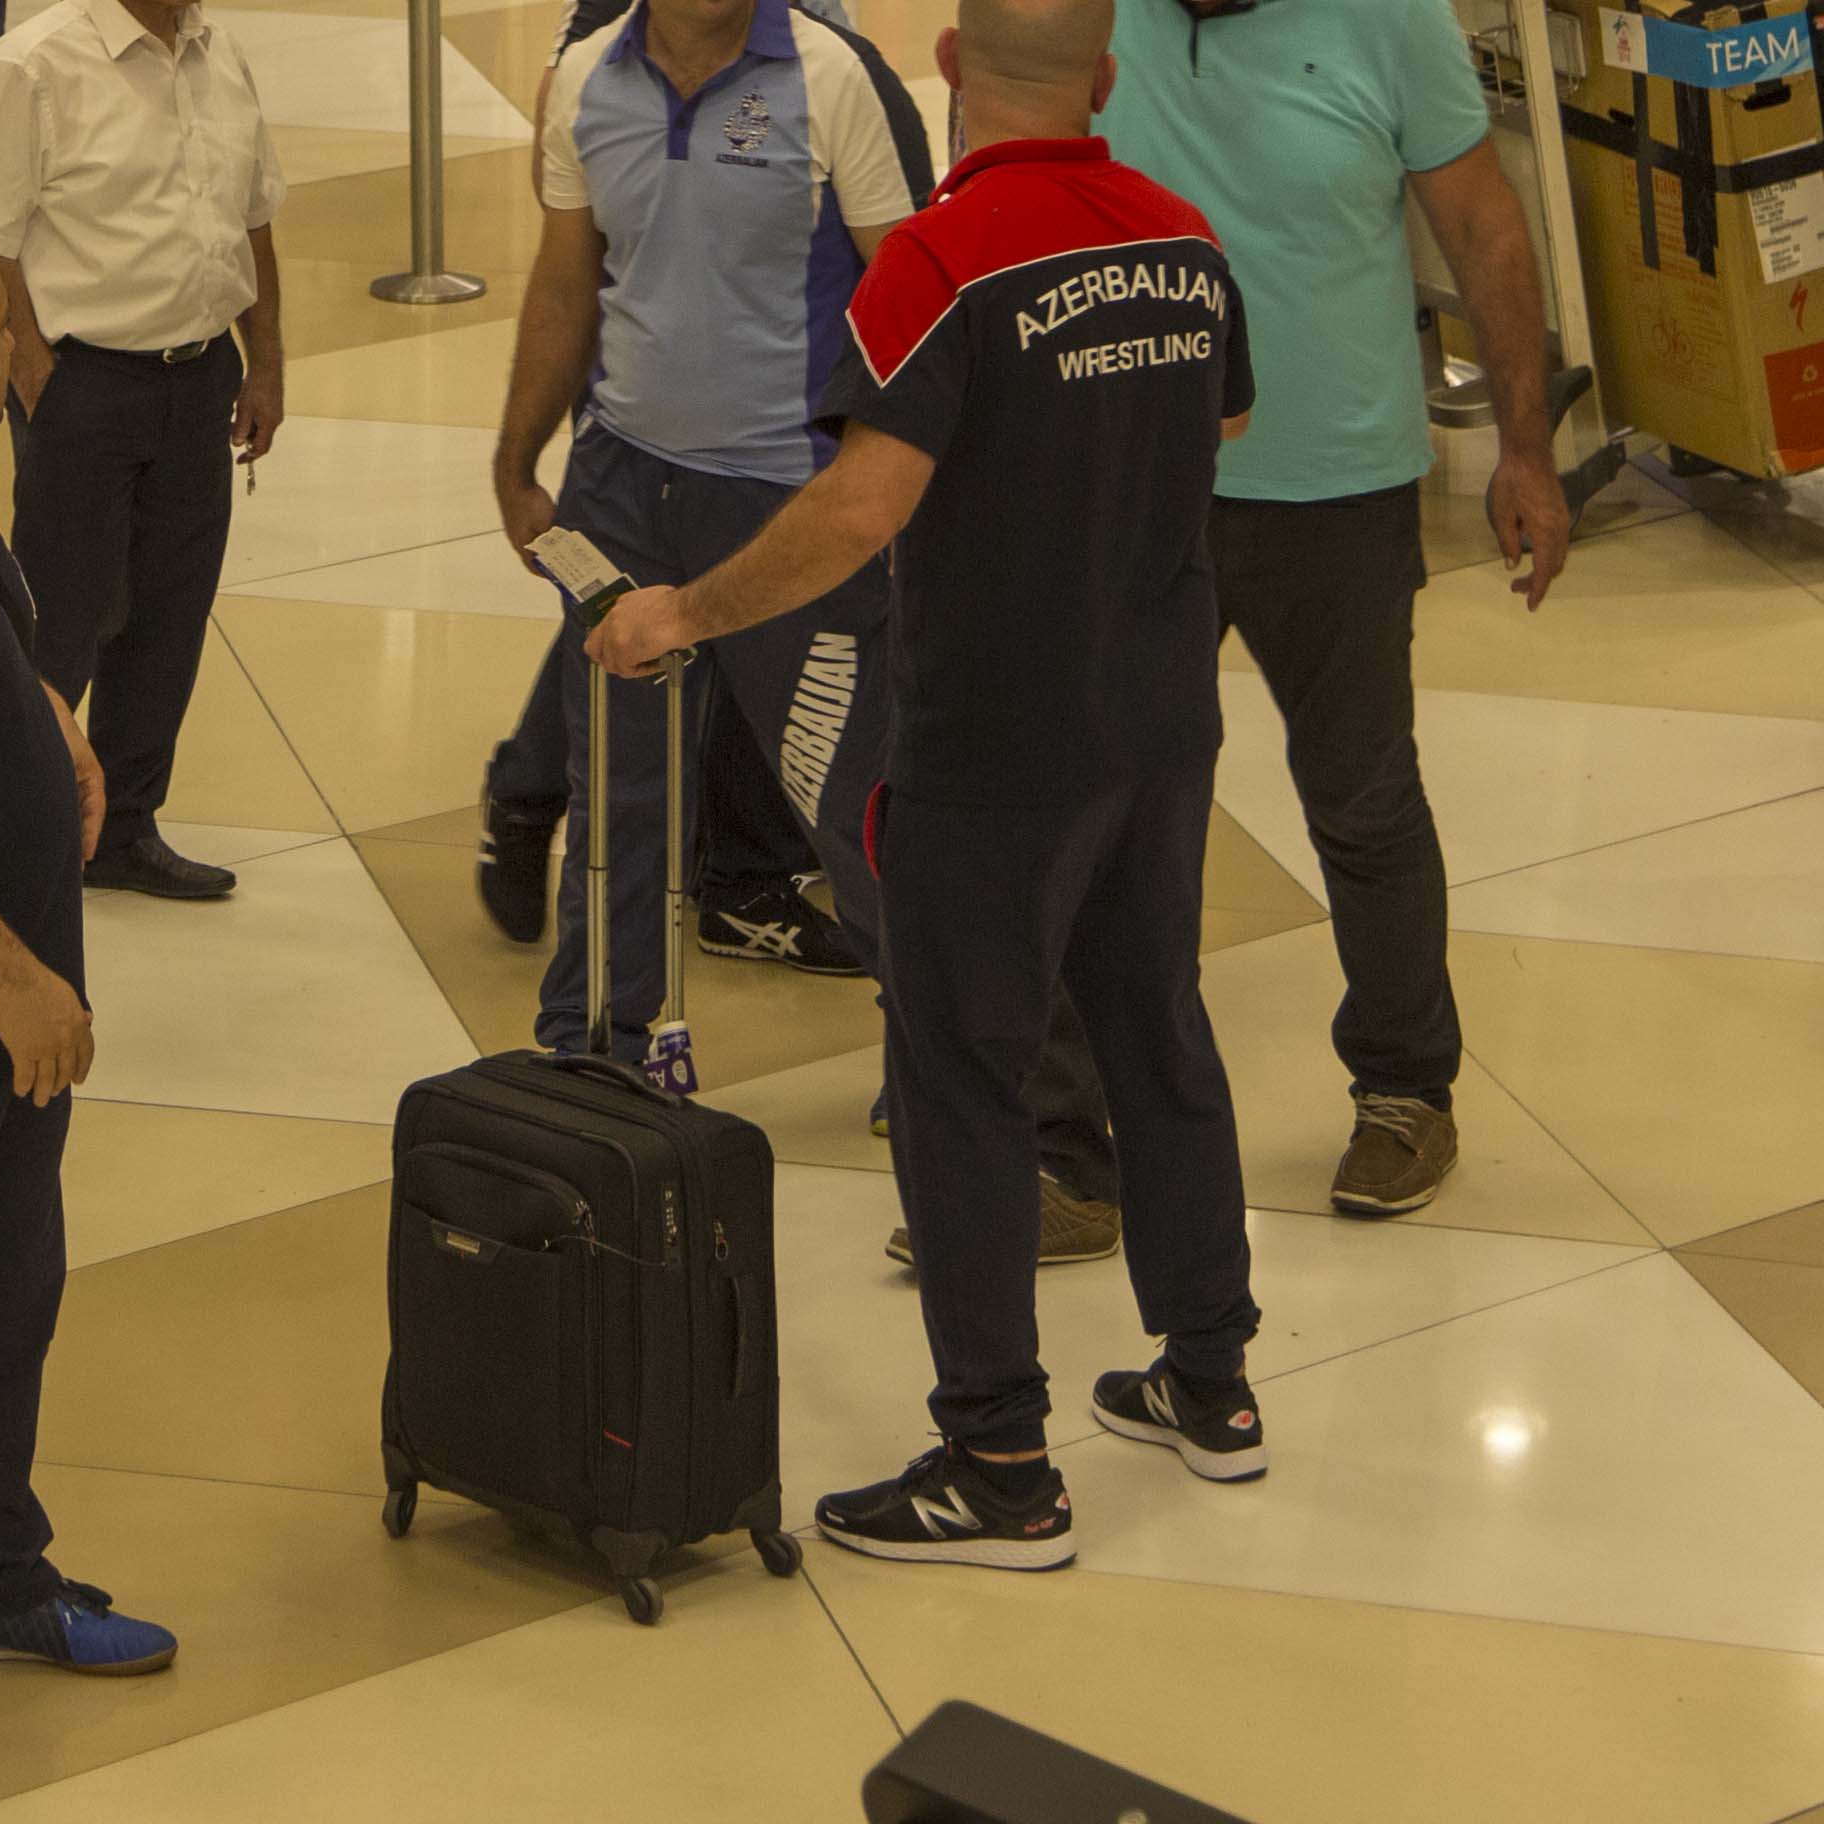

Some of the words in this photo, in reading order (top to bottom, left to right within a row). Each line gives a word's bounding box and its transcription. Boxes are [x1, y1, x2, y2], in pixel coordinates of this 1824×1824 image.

[1705, 26, 1801, 75] TEAM
[1016, 263, 1226, 352] AZERBAIJAN
[1057, 330, 1212, 382] WRESTLING
[779, 632, 858, 828] AZERBAIJAN
